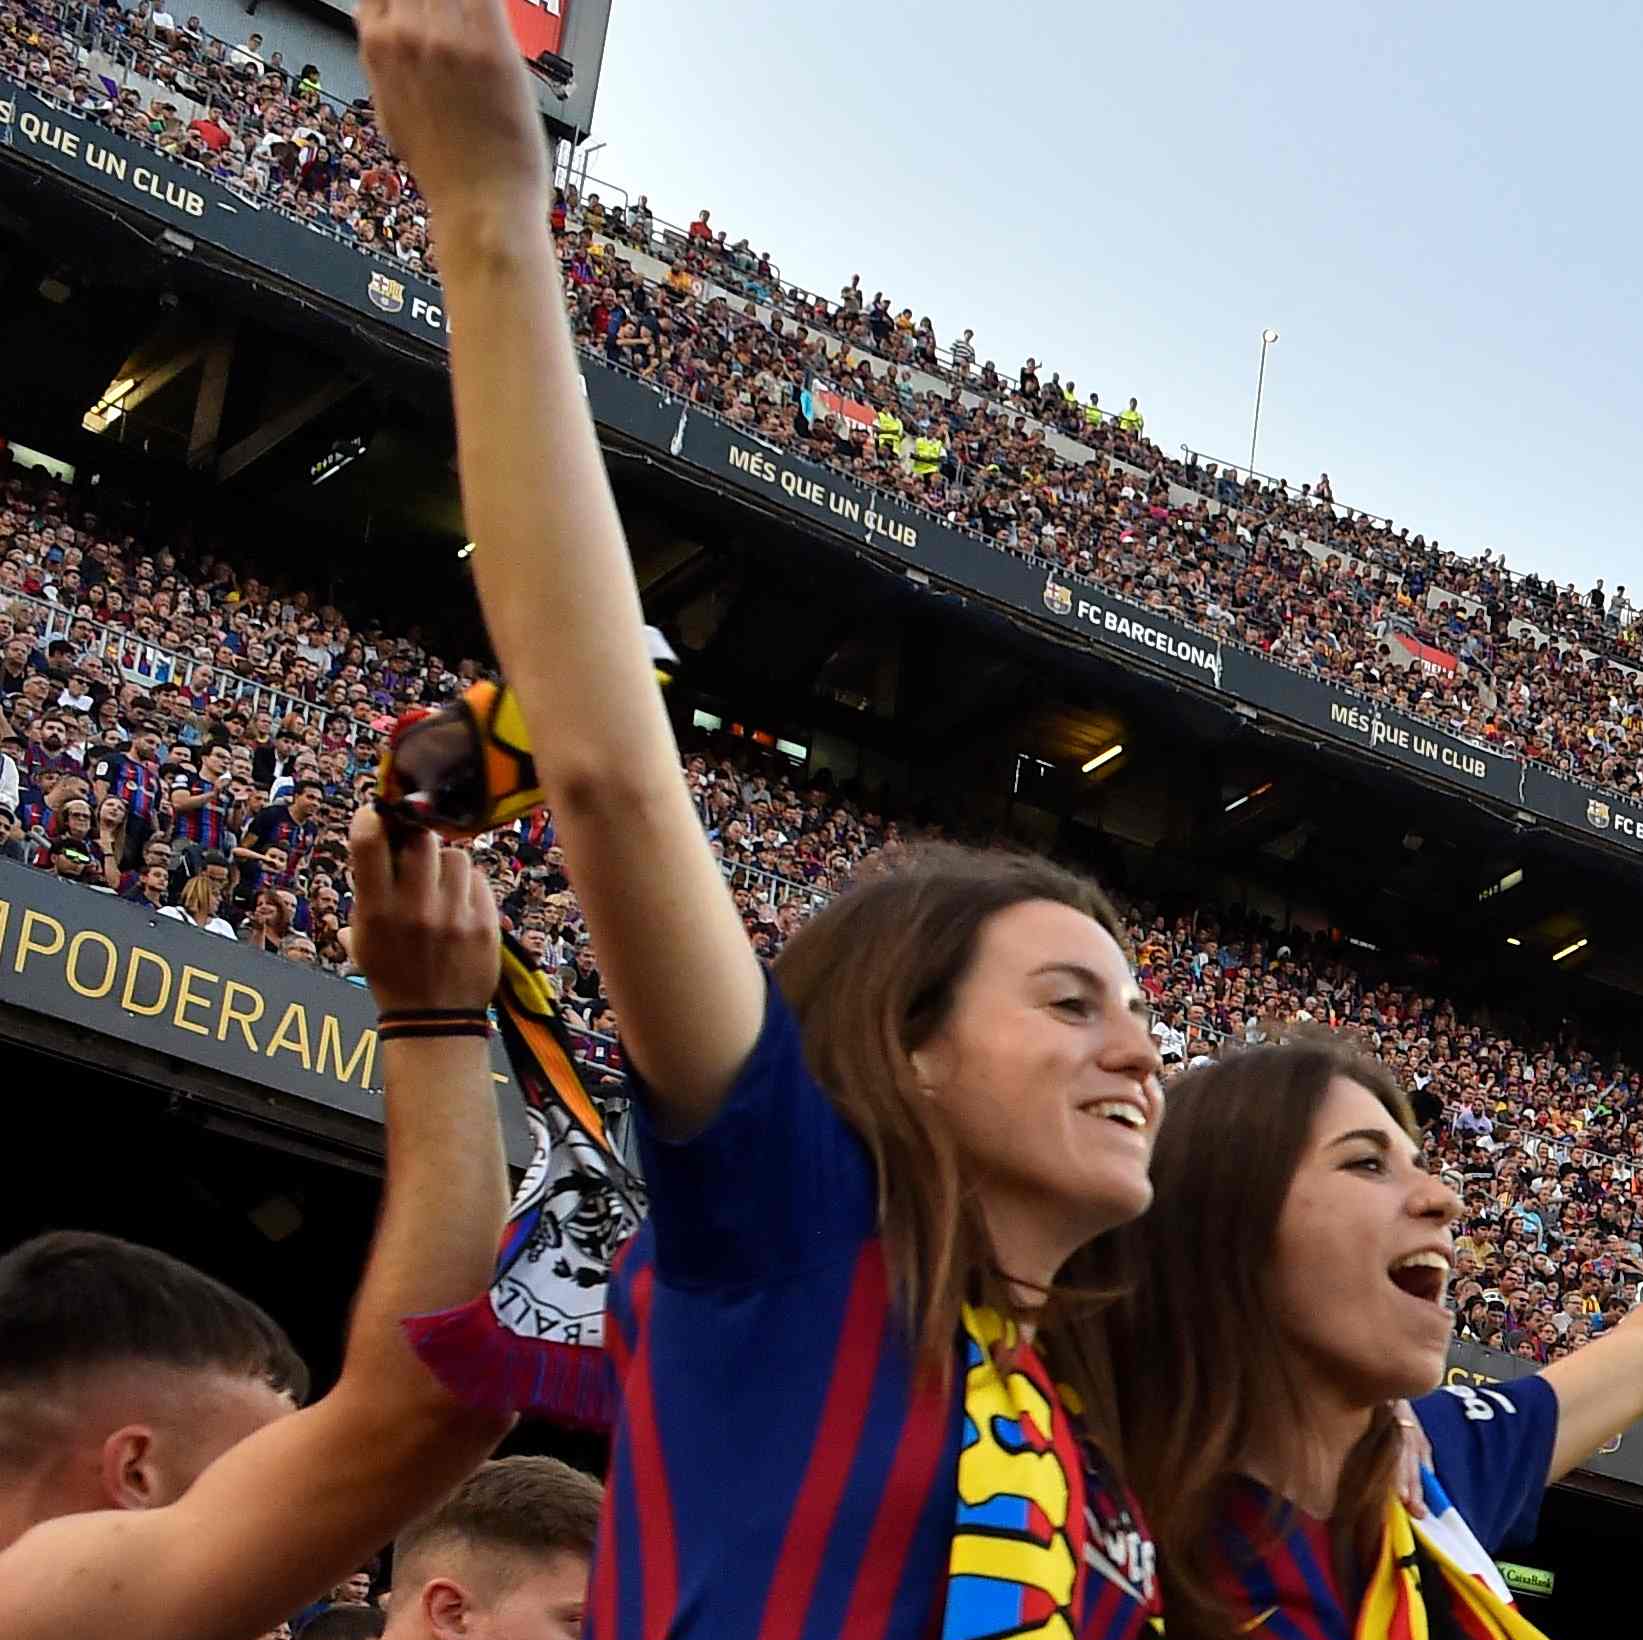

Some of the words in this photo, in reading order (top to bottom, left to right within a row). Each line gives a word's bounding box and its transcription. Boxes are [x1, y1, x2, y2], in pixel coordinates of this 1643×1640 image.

[20, 113, 81, 158] QUE
[86, 143, 128, 182] UN
[133, 166, 206, 218] CLUB
[411, 297, 441, 328] FC
[728, 442, 776, 482] MÉS
[781, 471, 825, 505] QUE
[829, 494, 859, 527] UN
[864, 510, 917, 549] CLUB
[1077, 600, 1102, 625] FC
[1103, 610, 1219, 672] BARCELONA
[1329, 702, 1369, 730] MÉS
[1374, 719, 1410, 749] QUE
[1413, 733, 1438, 760] UN
[1441, 744, 1486, 778] CLUB
[1613, 814, 1635, 833] FC
